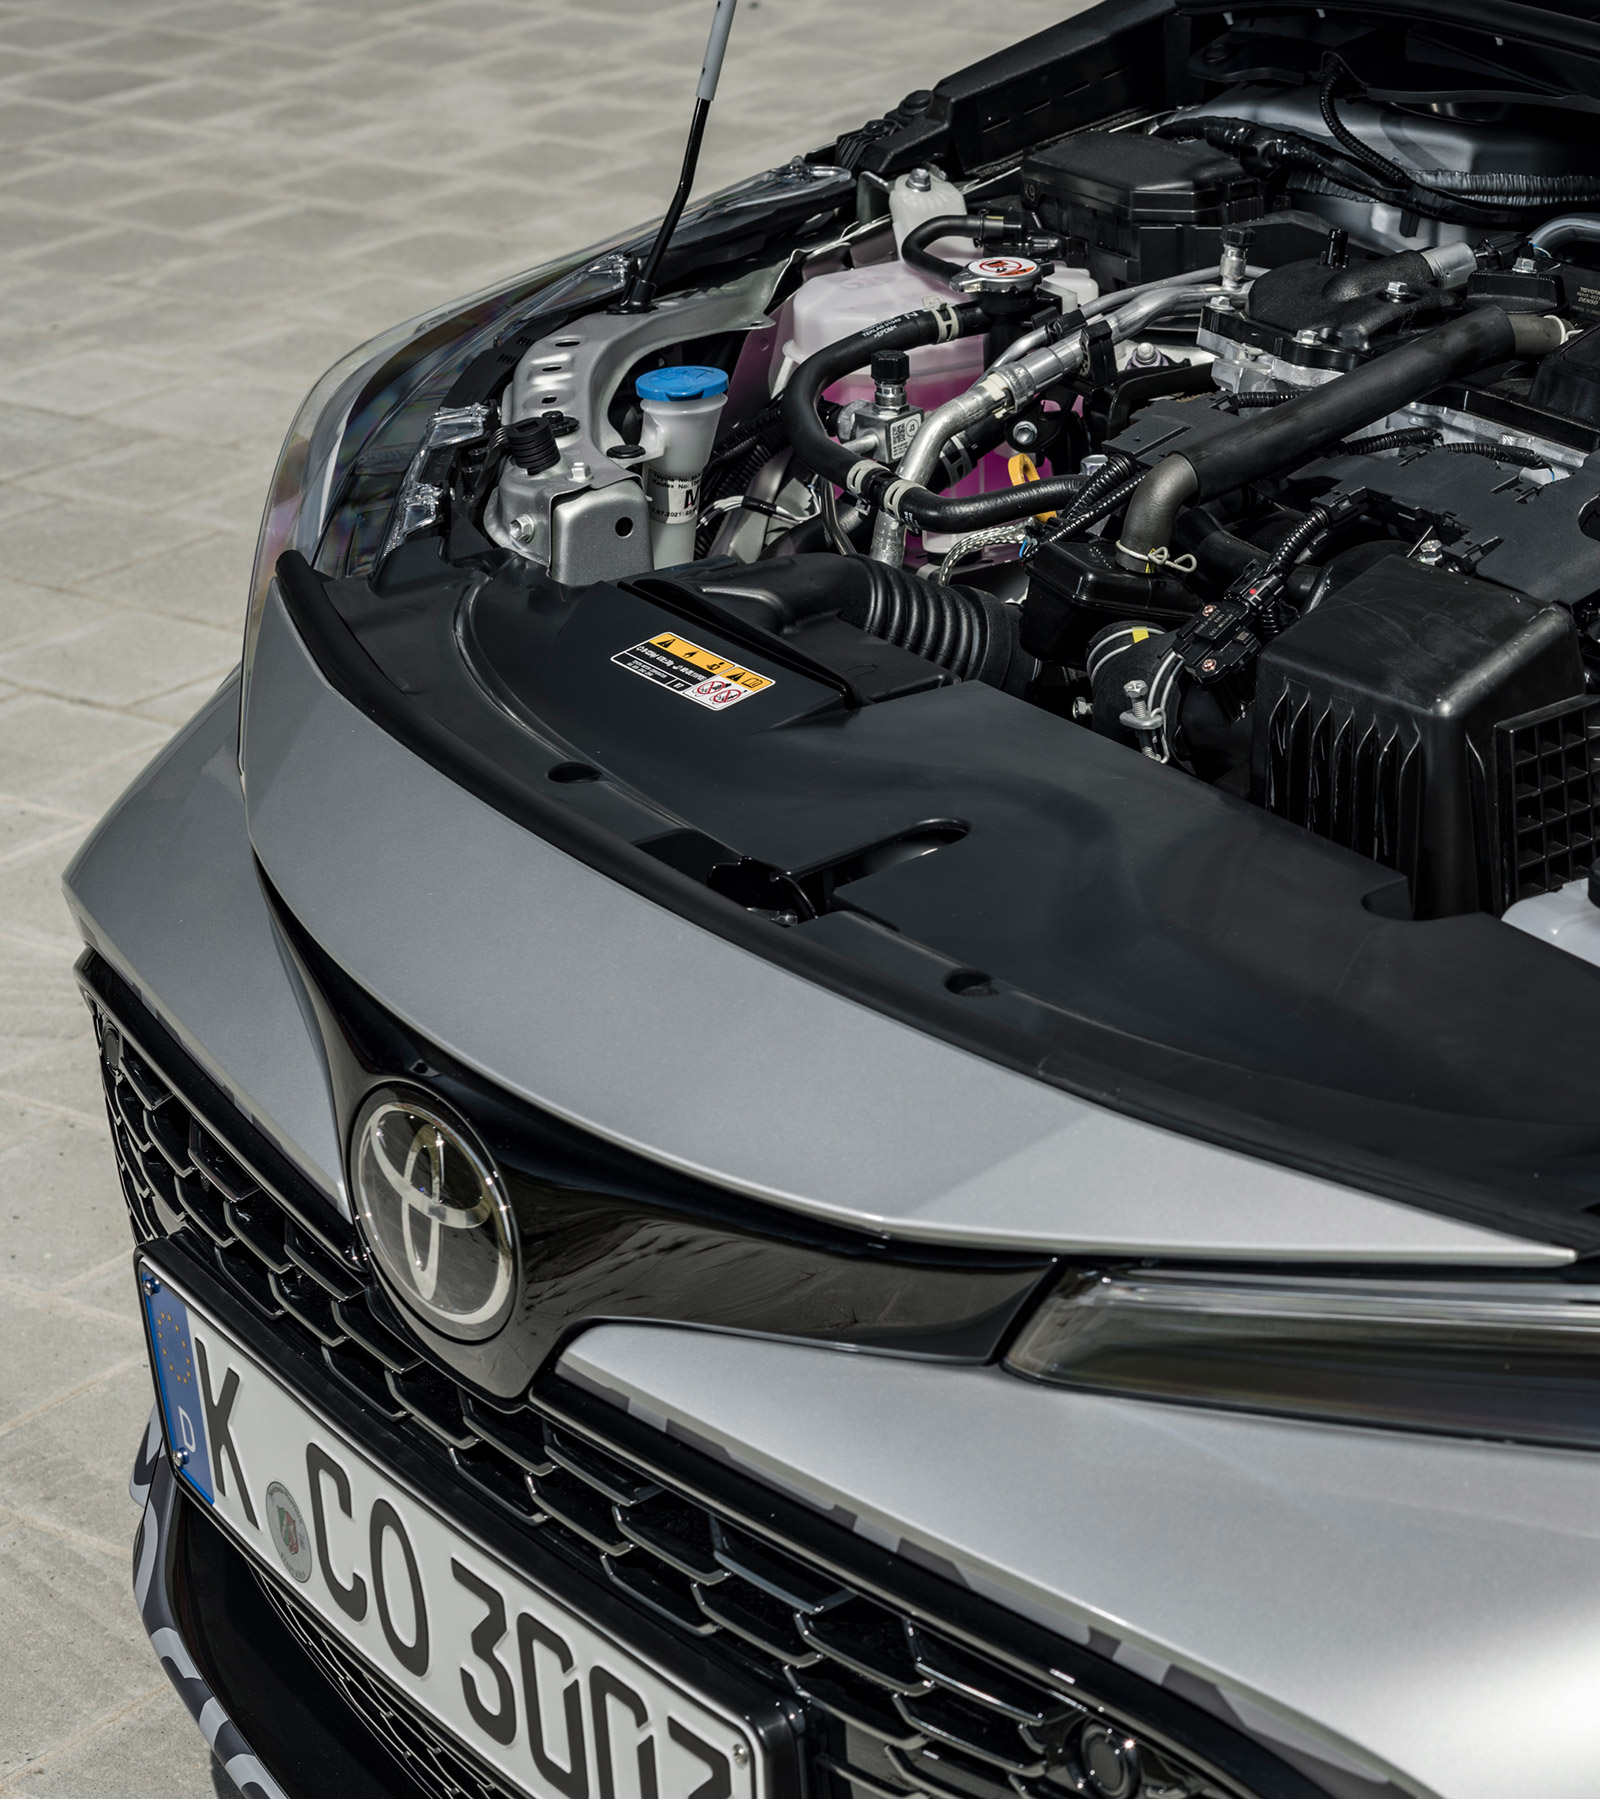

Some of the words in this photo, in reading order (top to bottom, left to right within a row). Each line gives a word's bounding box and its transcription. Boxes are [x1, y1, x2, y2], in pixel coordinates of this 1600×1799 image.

[177, 1404, 194, 1454] D
[194, 1336, 262, 1532] K
[305, 1441, 431, 1678] CO
